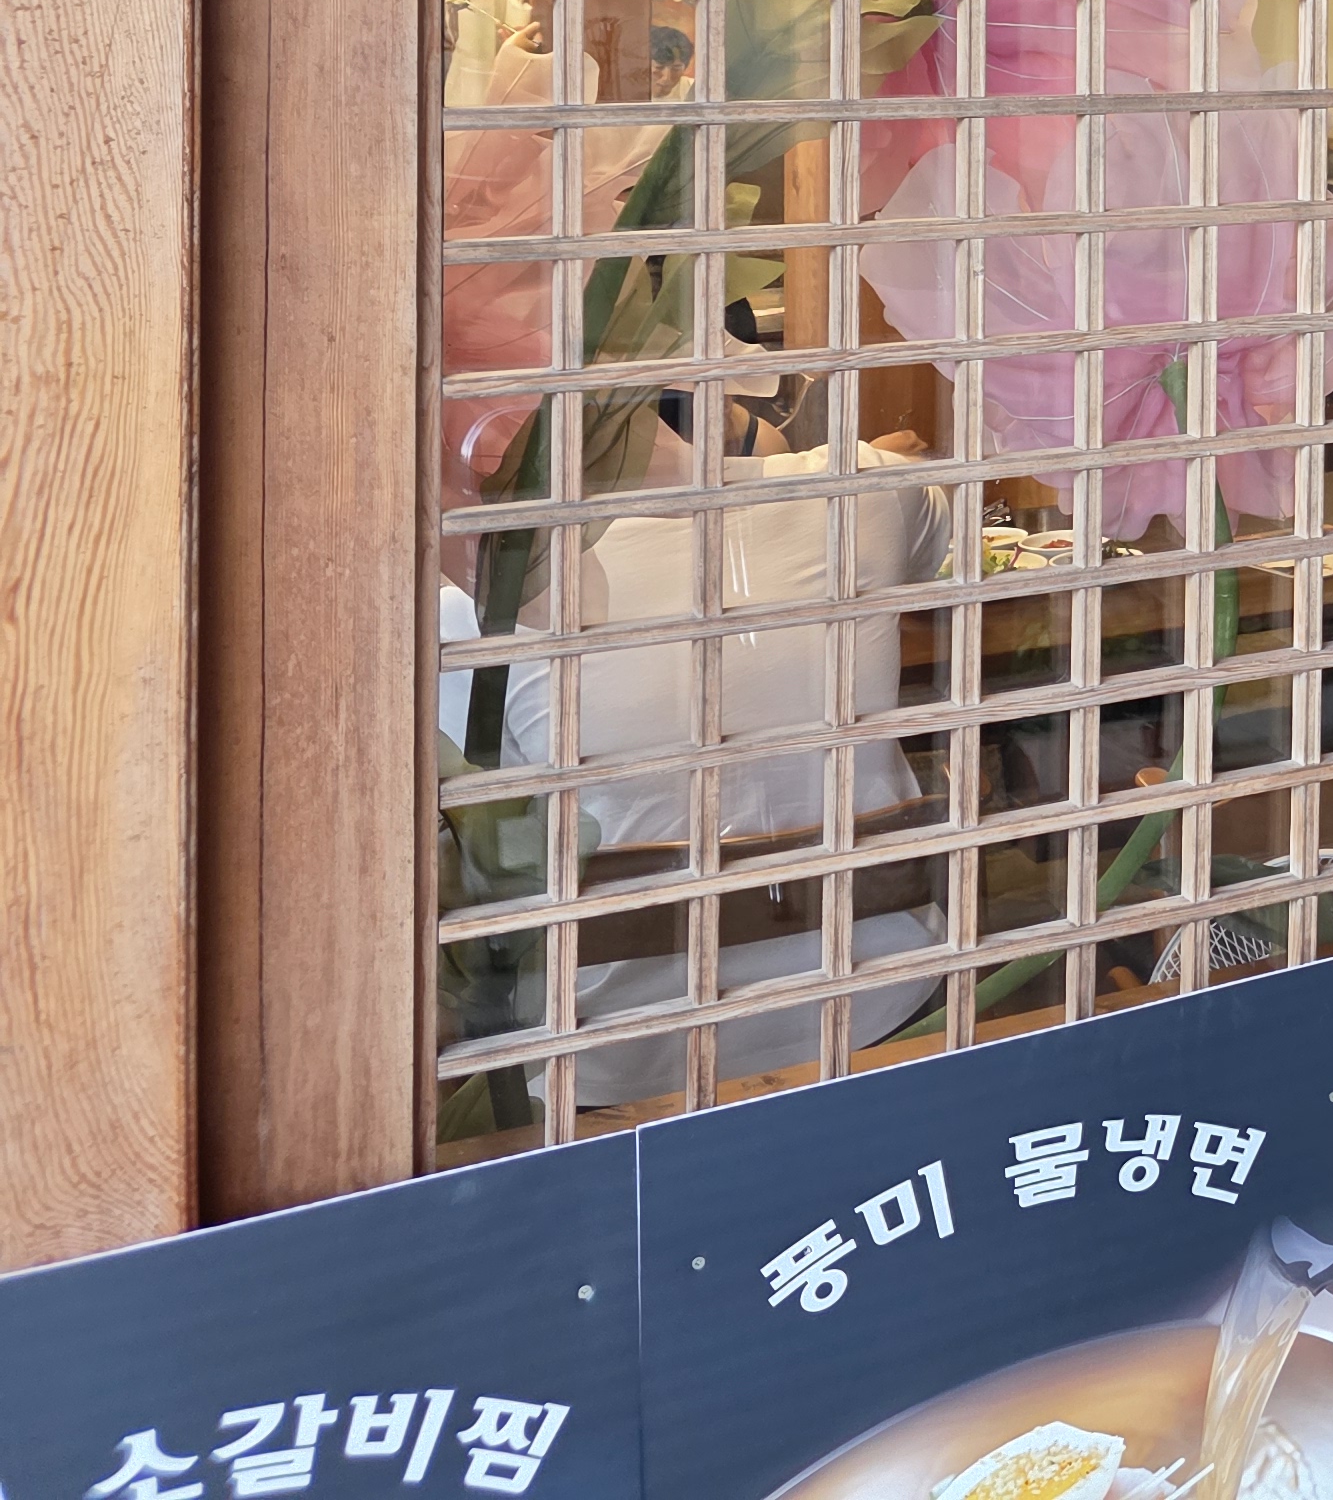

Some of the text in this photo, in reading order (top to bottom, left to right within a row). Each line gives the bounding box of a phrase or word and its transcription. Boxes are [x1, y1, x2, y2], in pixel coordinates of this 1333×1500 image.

[760, 1113, 1267, 1313] 풍미 물냉면
[85, 1388, 571, 1500] 소갈비찜
